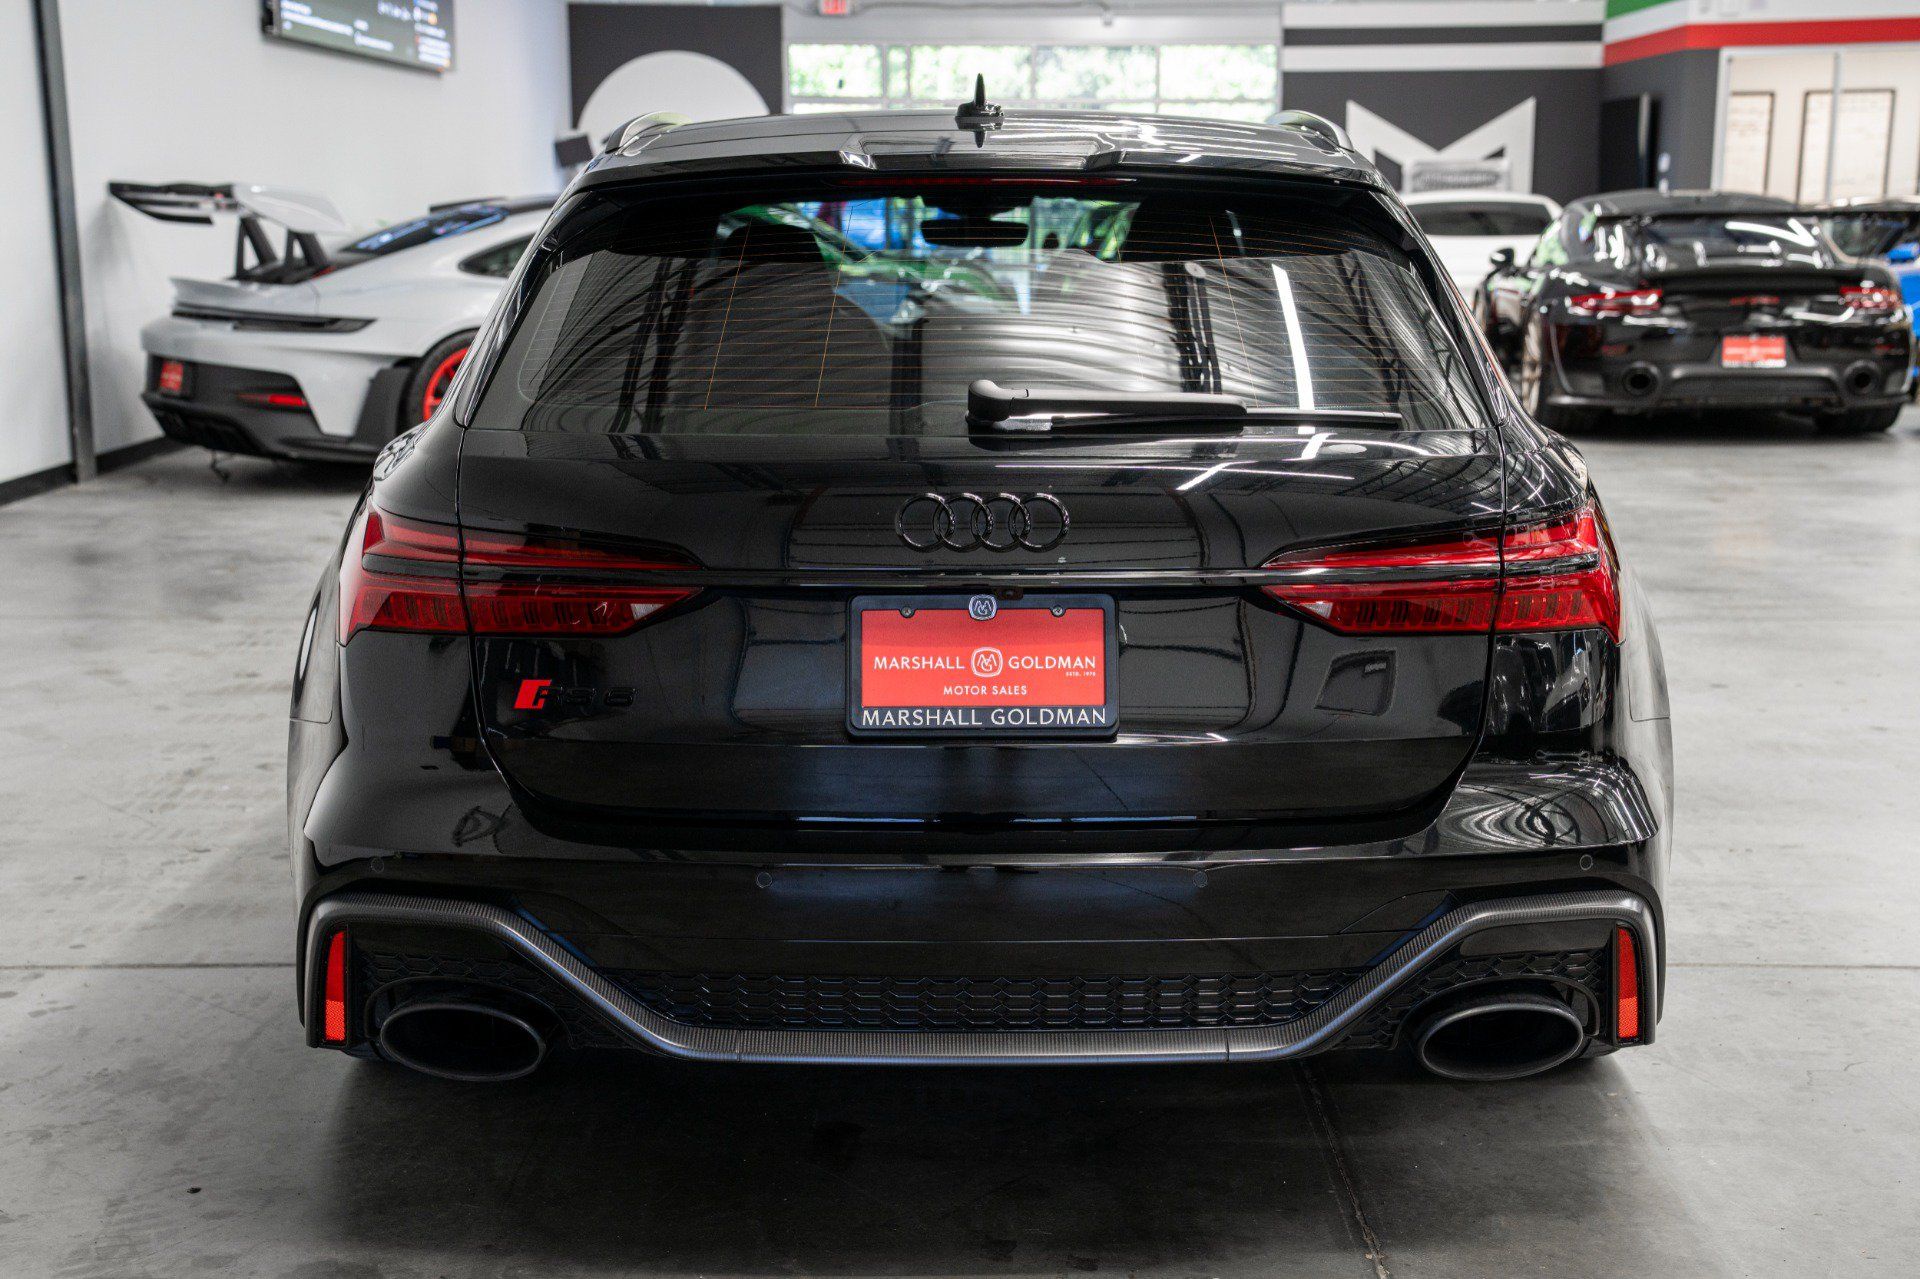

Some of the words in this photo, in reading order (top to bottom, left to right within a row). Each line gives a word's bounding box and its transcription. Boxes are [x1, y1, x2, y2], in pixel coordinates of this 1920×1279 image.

[874, 656, 964, 670] MARSHALL
[1008, 656, 1096, 669] GOLDMAN
[943, 686, 987, 696] MOTOR
[992, 685, 1027, 696] SALES
[862, 709, 982, 726] MARSHALL
[991, 708, 1106, 725] GOLDMAN
